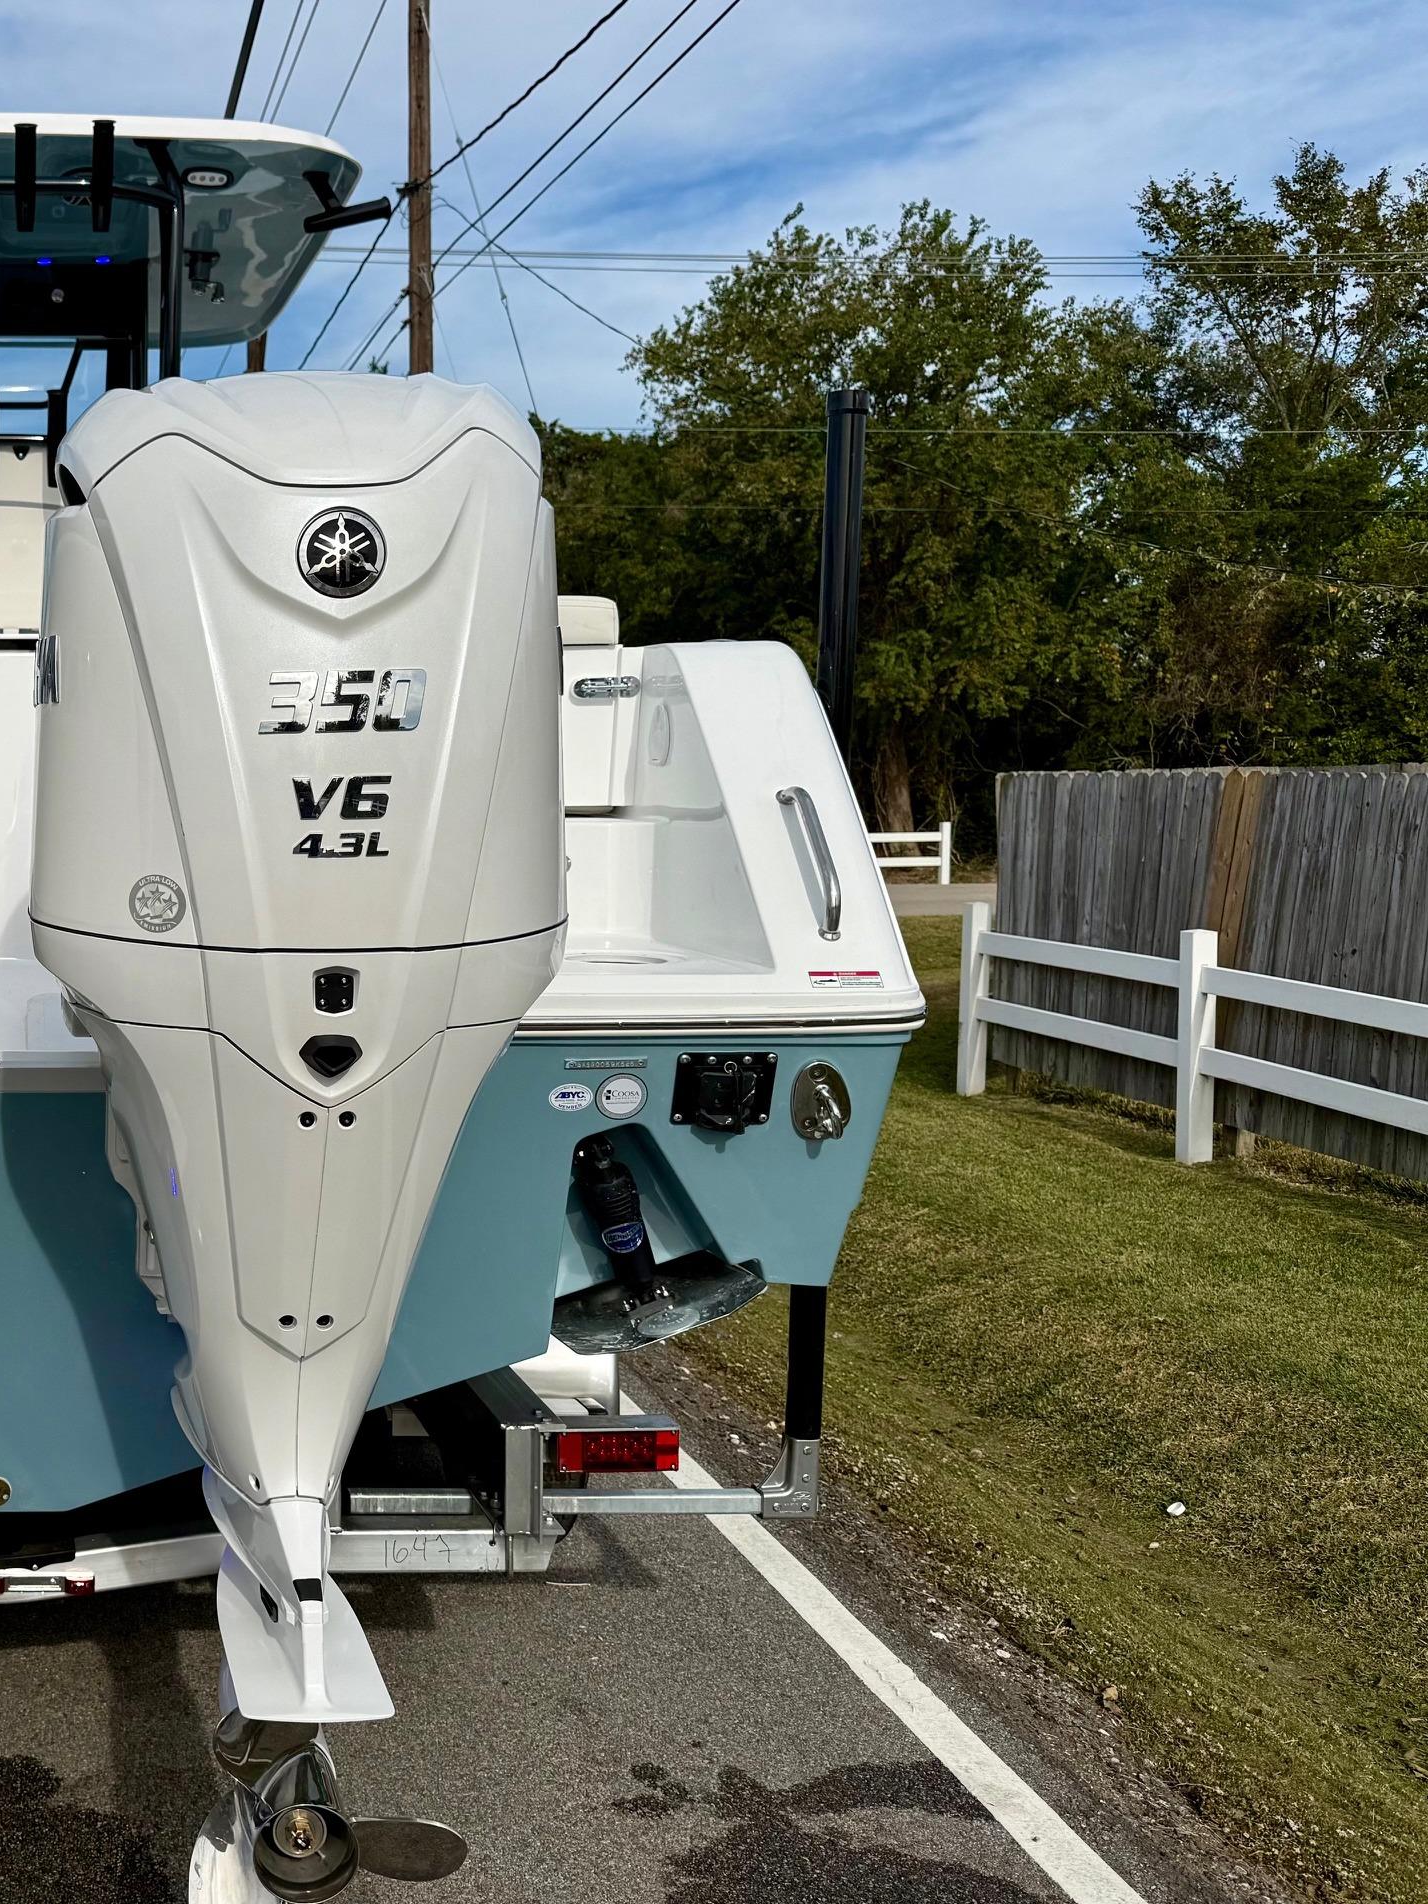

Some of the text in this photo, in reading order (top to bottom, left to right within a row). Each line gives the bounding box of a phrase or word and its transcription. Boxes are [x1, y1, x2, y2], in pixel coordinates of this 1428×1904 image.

[258, 668, 427, 734] 350
[292, 775, 392, 820] V6
[292, 832, 389, 858] 4.3L
[138, 875, 179, 890] ULTRA LOW
